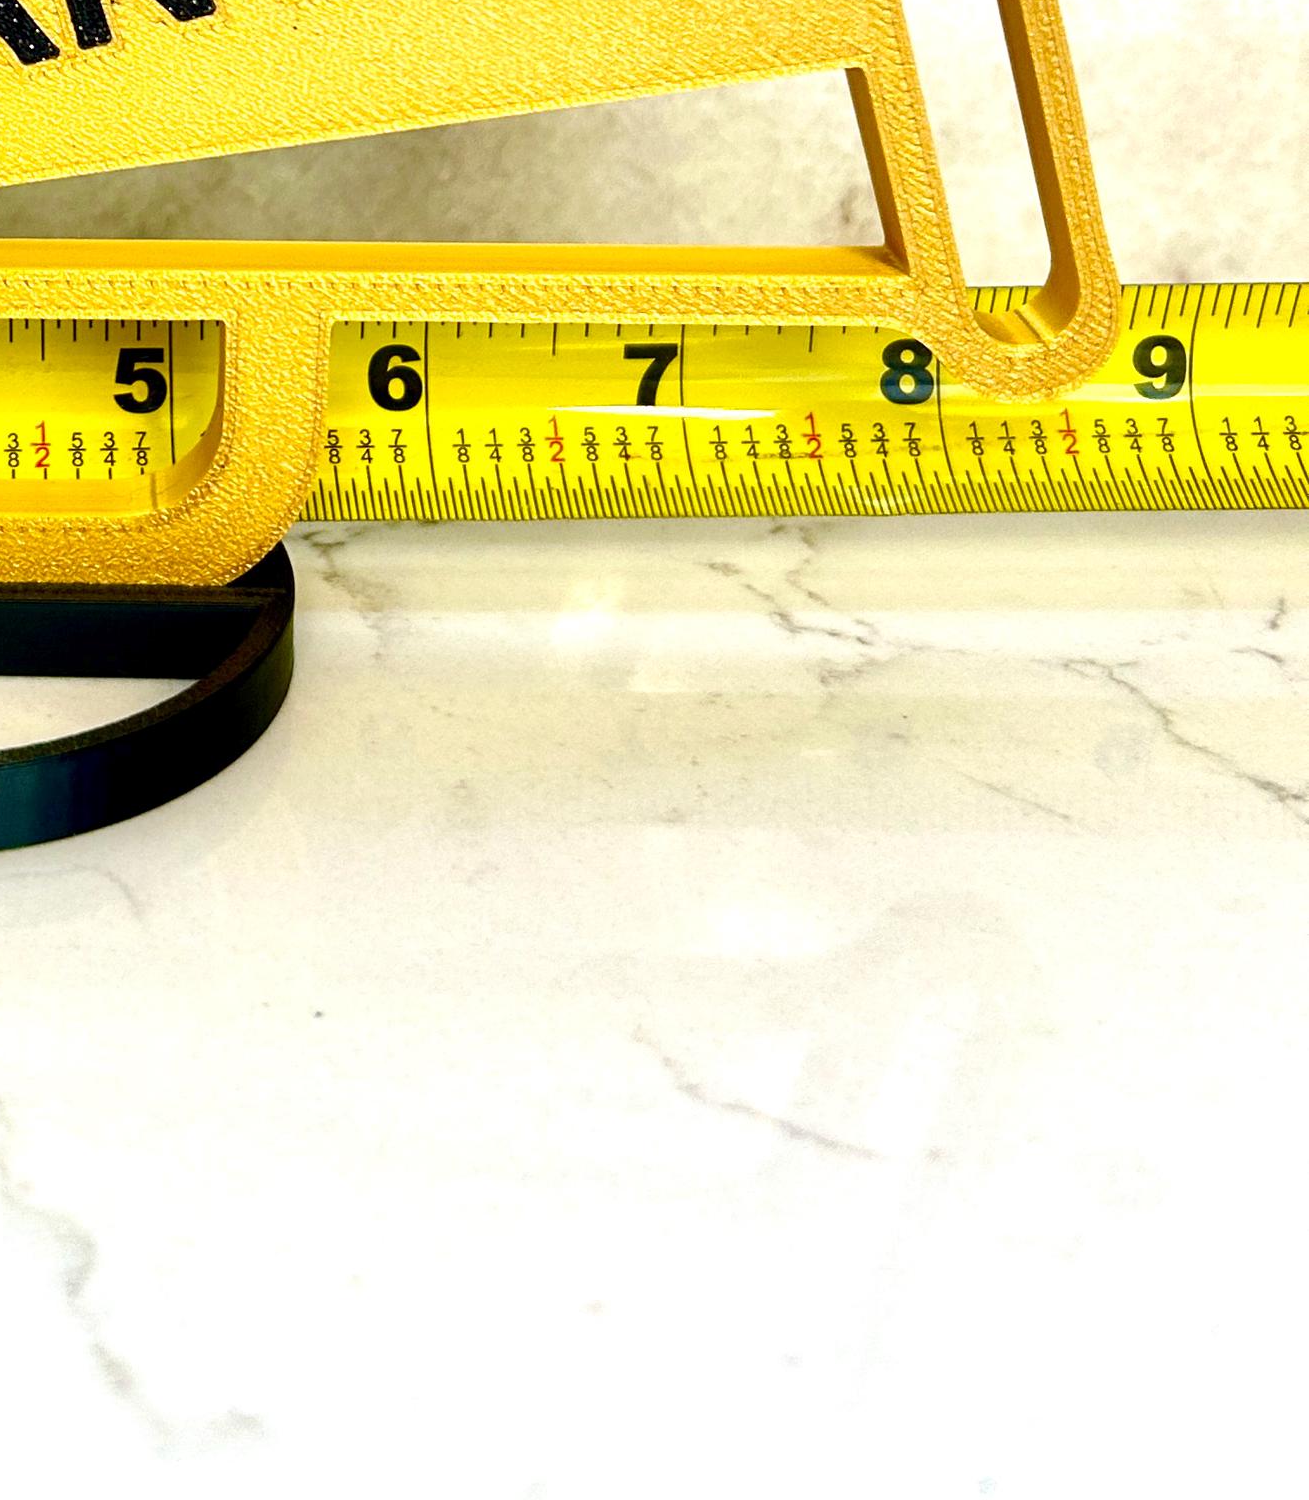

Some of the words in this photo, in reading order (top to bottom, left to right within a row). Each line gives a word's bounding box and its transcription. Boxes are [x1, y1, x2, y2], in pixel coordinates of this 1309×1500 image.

[113, 347, 168, 415] 5
[367, 344, 423, 412] 6
[623, 343, 679, 408] 7
[879, 338, 935, 406] 8
[1132, 335, 1188, 401] 9
